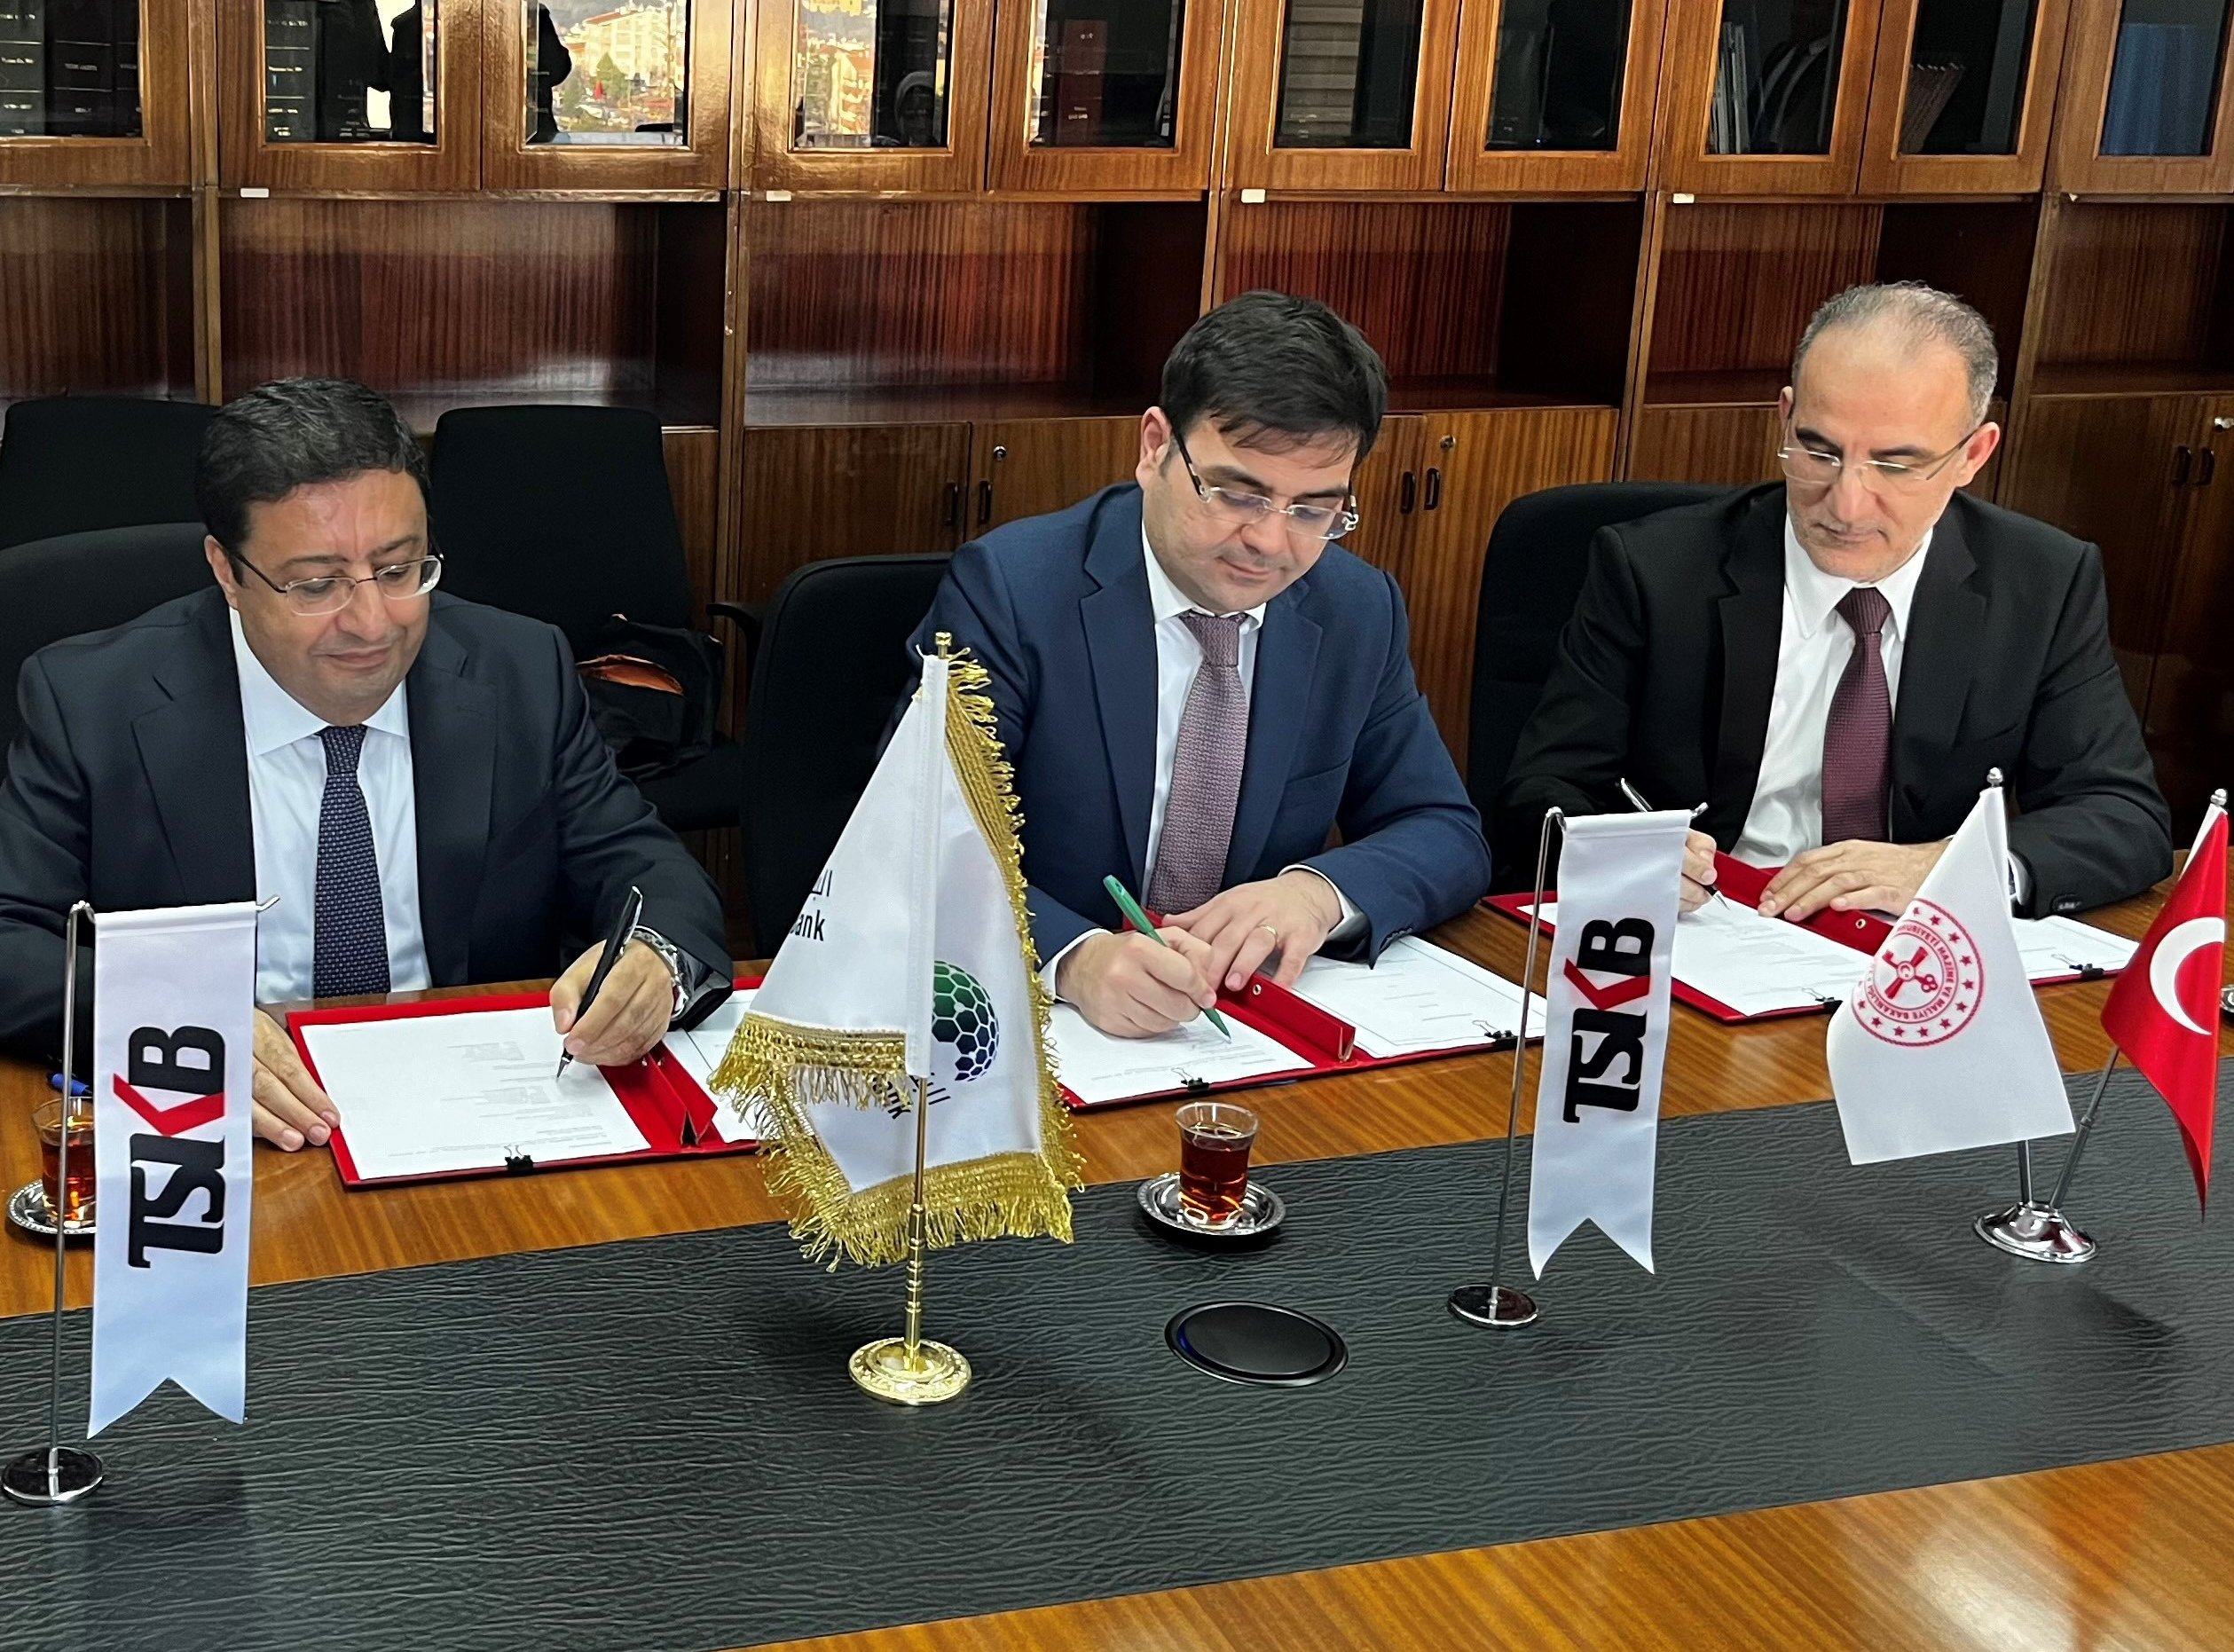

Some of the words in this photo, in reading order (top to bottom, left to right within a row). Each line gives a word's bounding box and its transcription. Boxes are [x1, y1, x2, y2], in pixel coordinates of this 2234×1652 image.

[789, 909, 825, 941] ank
[1563, 917, 1656, 1123] TSKB
[113, 1026, 225, 1269] TSKB
